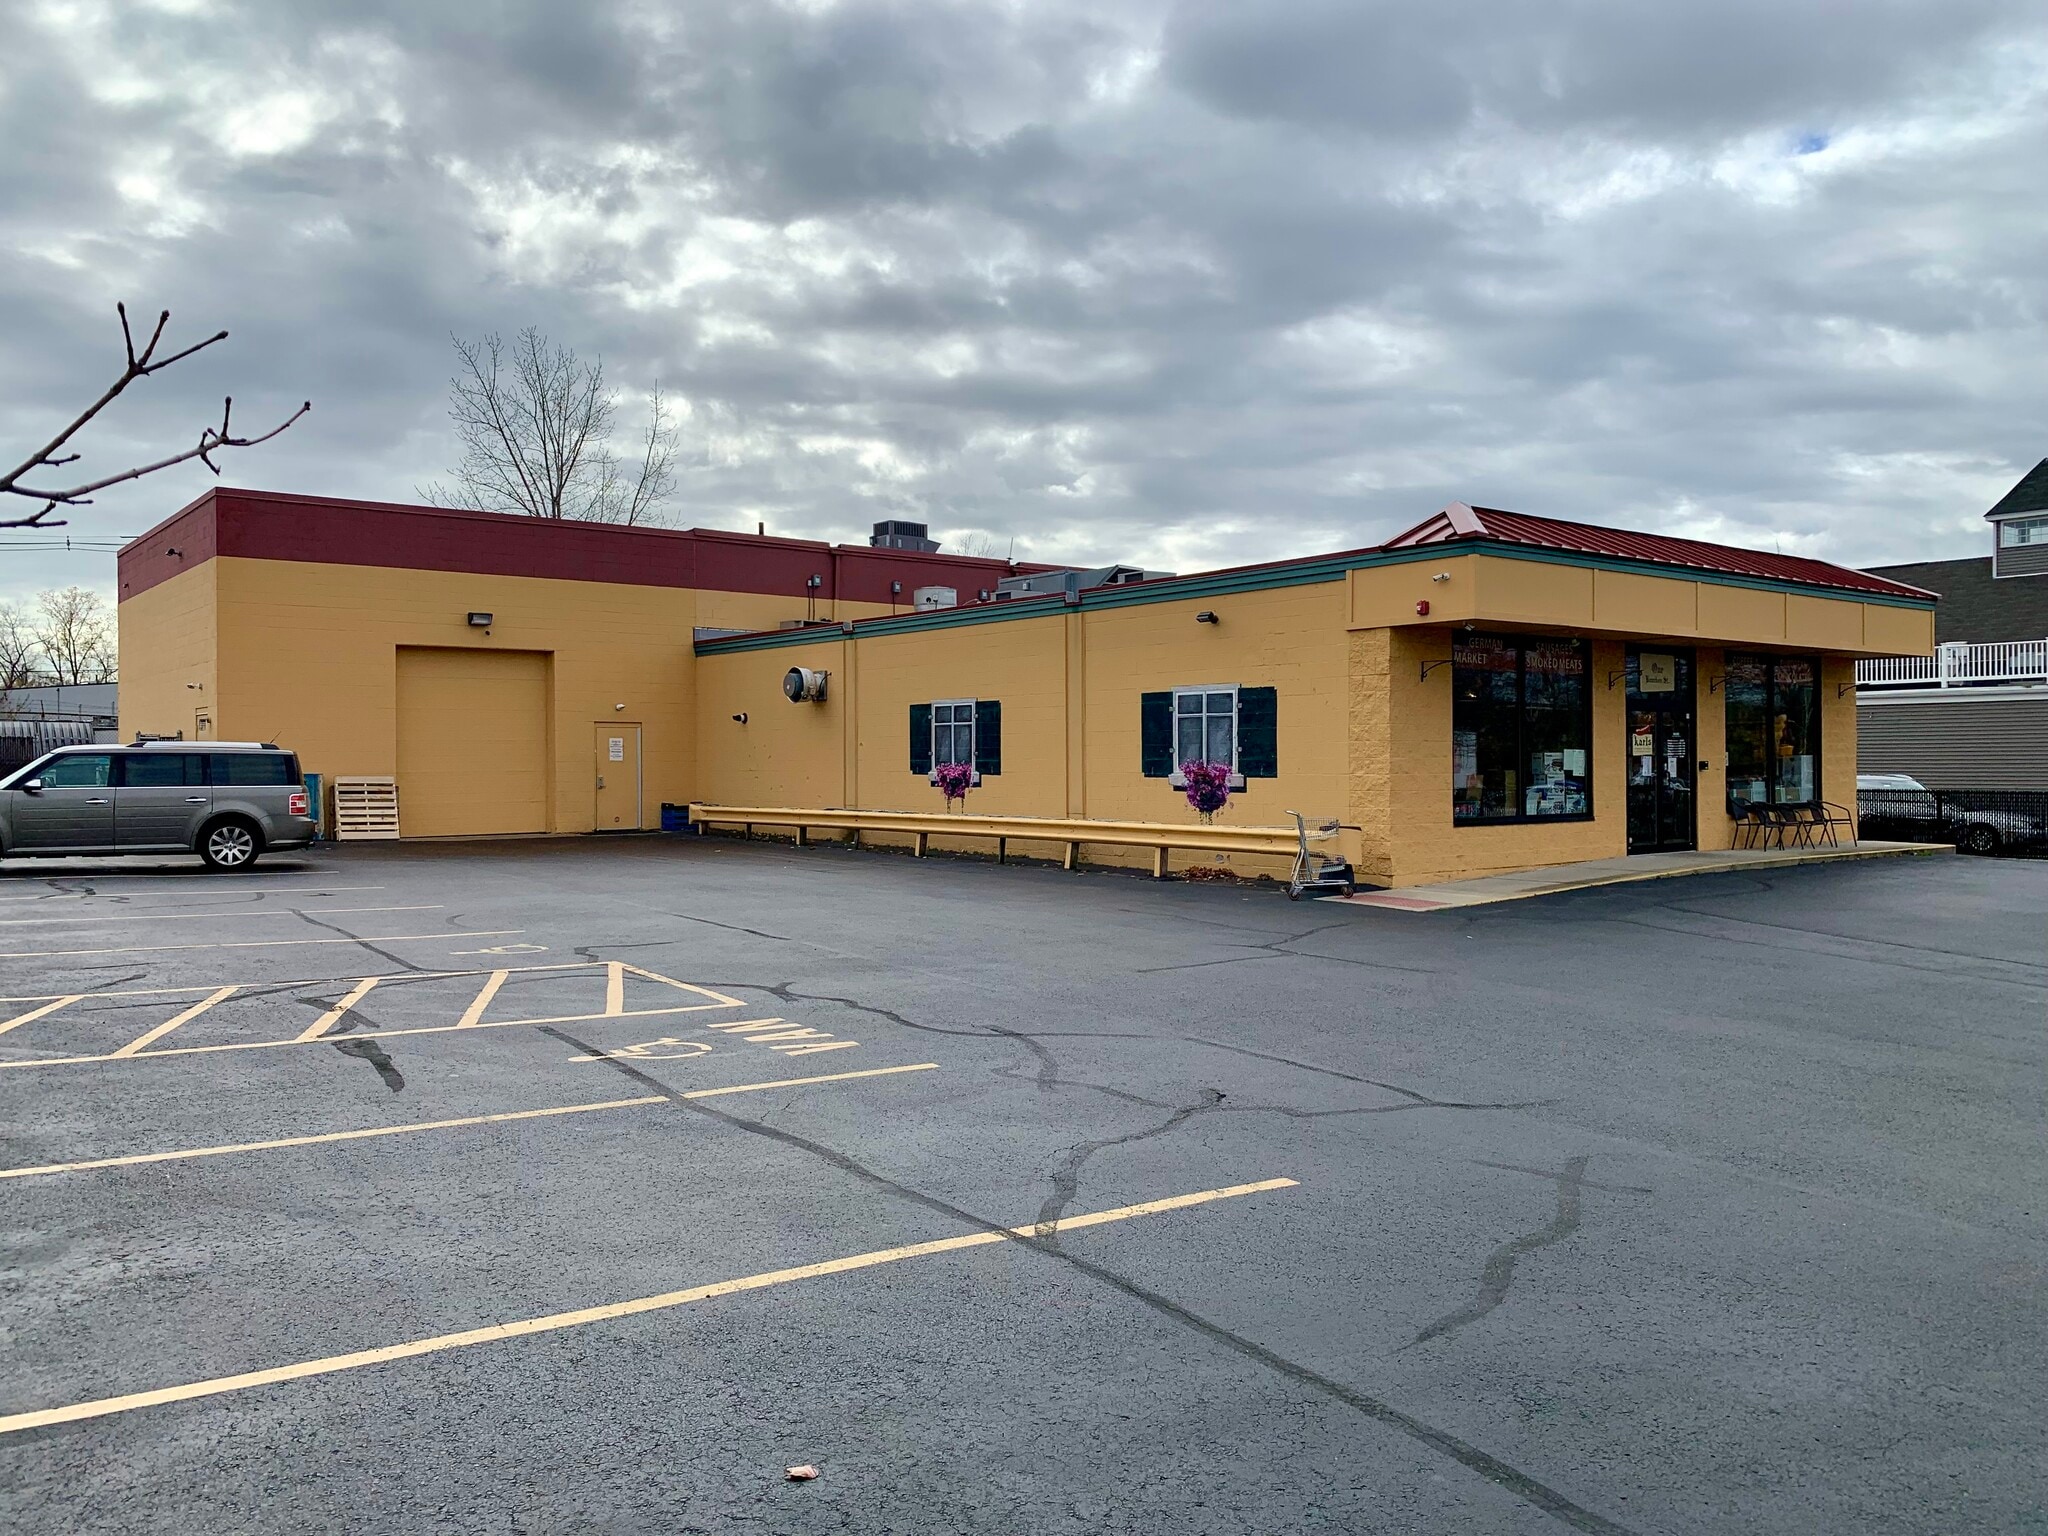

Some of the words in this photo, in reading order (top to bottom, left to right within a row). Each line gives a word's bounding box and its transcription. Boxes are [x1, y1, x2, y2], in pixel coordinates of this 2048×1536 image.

[1468, 637, 1503, 650] GERMAN
[1535, 642, 1574, 655] SAUSAGES
[1453, 651, 1488, 665] MARKET
[1526, 656, 1558, 669] SMOKED
[1559, 658, 1583, 670] MEATS
[706, 1017, 860, 1057] VAN
